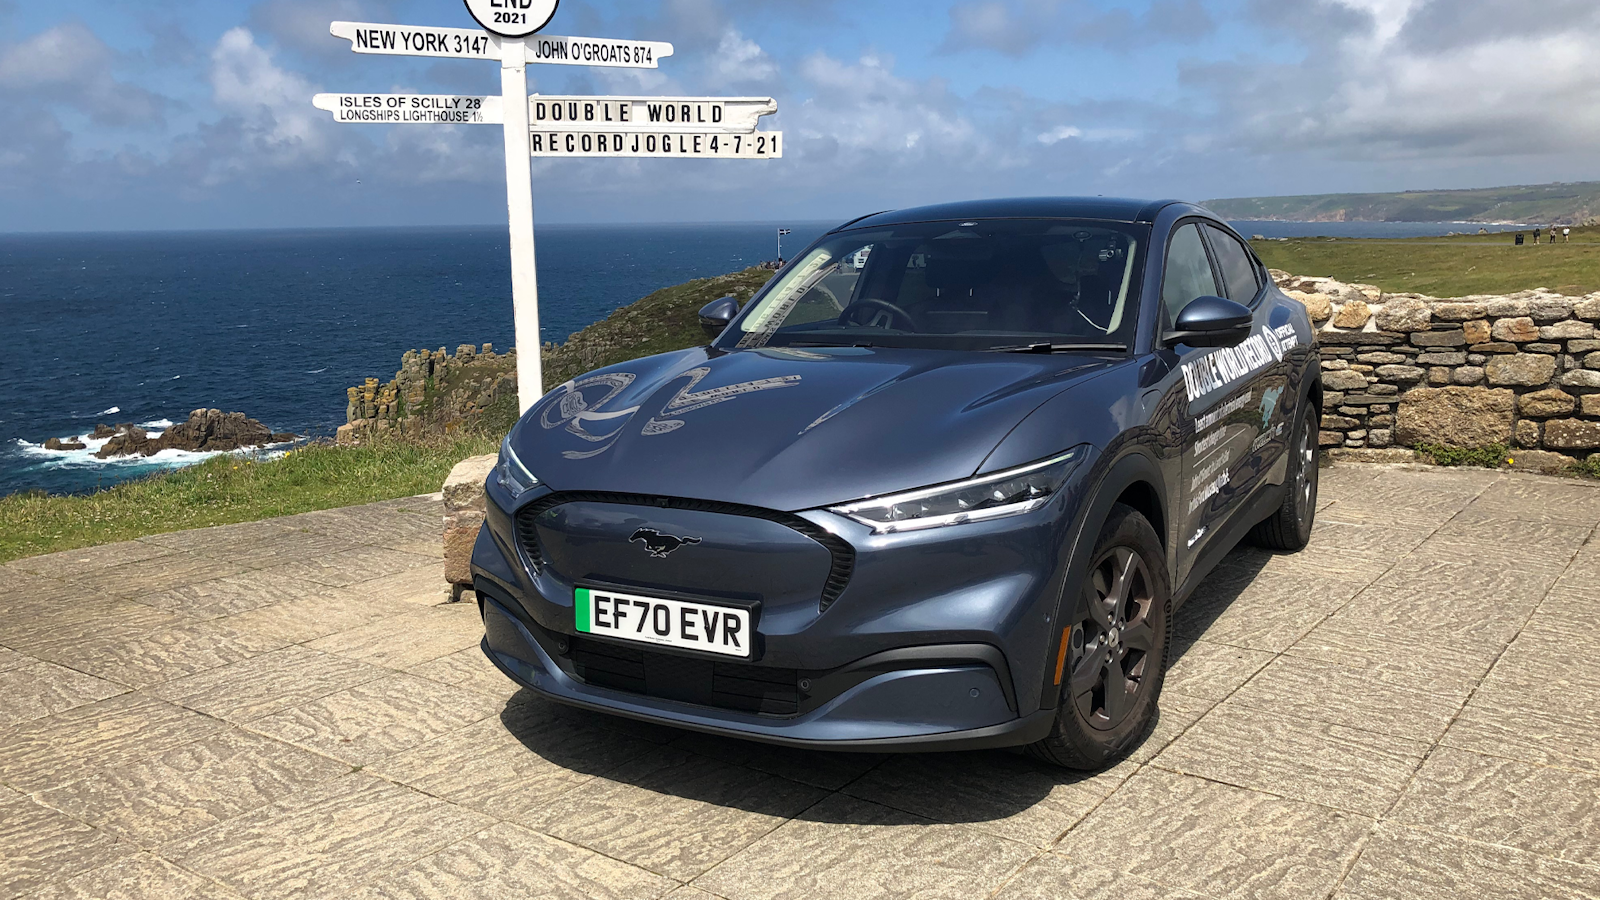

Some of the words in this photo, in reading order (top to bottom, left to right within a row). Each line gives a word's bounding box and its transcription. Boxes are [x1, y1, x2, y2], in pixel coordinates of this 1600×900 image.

[494, 12, 526, 24] 2021
[356, 29, 396, 50] NEW
[400, 31, 449, 53] YORK
[454, 35, 489, 55] 3147
[536, 40, 568, 59] JOHN
[571, 42, 631, 63] O'GROATS
[633, 46, 652, 64] 874
[340, 96, 382, 108] ISLES
[386, 97, 406, 108] OF
[411, 97, 461, 109] SCILLY
[465, 98, 481, 109] 28
[536, 102, 629, 122] DOUBLE
[647, 103, 723, 123] WORLD
[340, 110, 400, 121] LONGSHIPS
[403, 110, 469, 122] LIGHTHOUSE
[1181, 352, 1223, 403] DOUBLE
[1214, 343, 1250, 384] WORLD
[1242, 333, 1273, 371] RECORD
[594, 595, 671, 637] EF70
[681, 607, 742, 648] EVR
